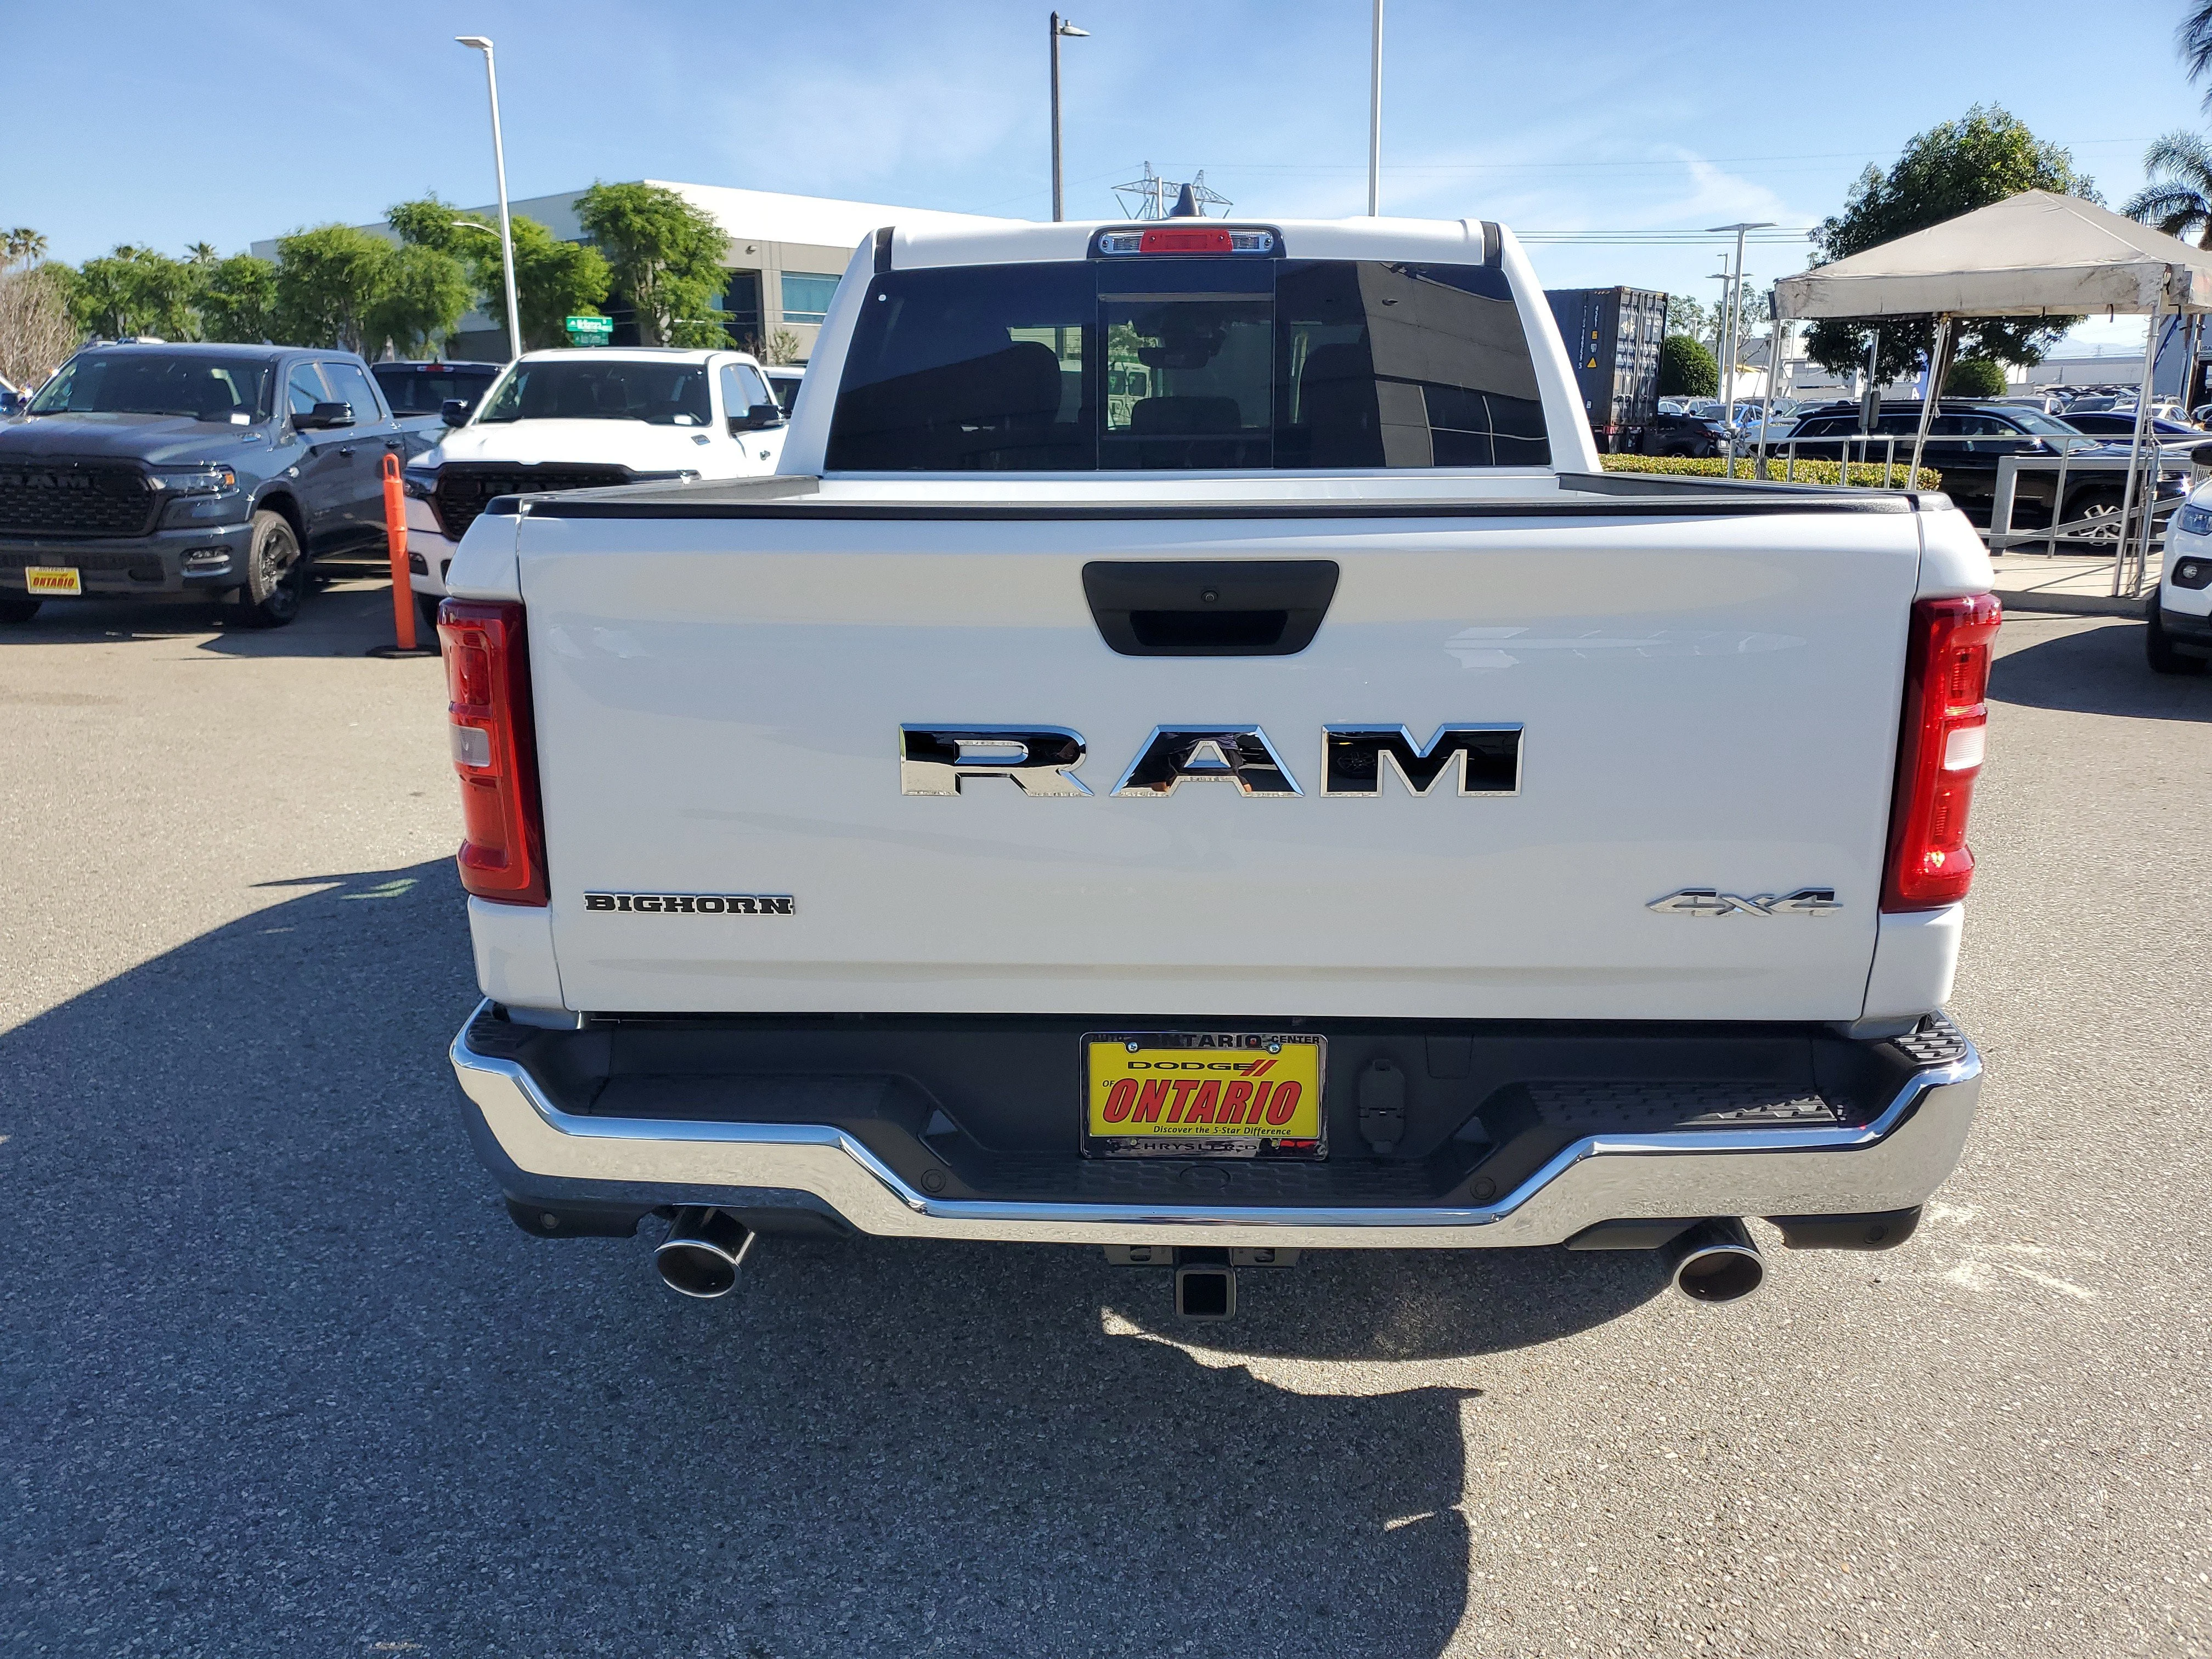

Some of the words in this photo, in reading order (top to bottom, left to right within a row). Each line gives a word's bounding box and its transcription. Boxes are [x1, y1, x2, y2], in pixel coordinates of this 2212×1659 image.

[0, 475, 89, 488] RAM
[33, 577, 74, 588] ONTARIO
[899, 723, 1526, 798] RAM
[583, 890, 796, 916] BIGHORN
[1271, 1035, 1320, 1044] CENTER
[1127, 1061, 1256, 1071] DODGE
[1102, 1079, 1115, 1087] OF
[1102, 1077, 1303, 1126] ONTARIO
[1153, 1125, 1193, 1134] Discover
[1195, 1126, 1210, 1134] the
[1213, 1126, 1241, 1135] 5-Star
[1244, 1127, 1291, 1137] Difference
